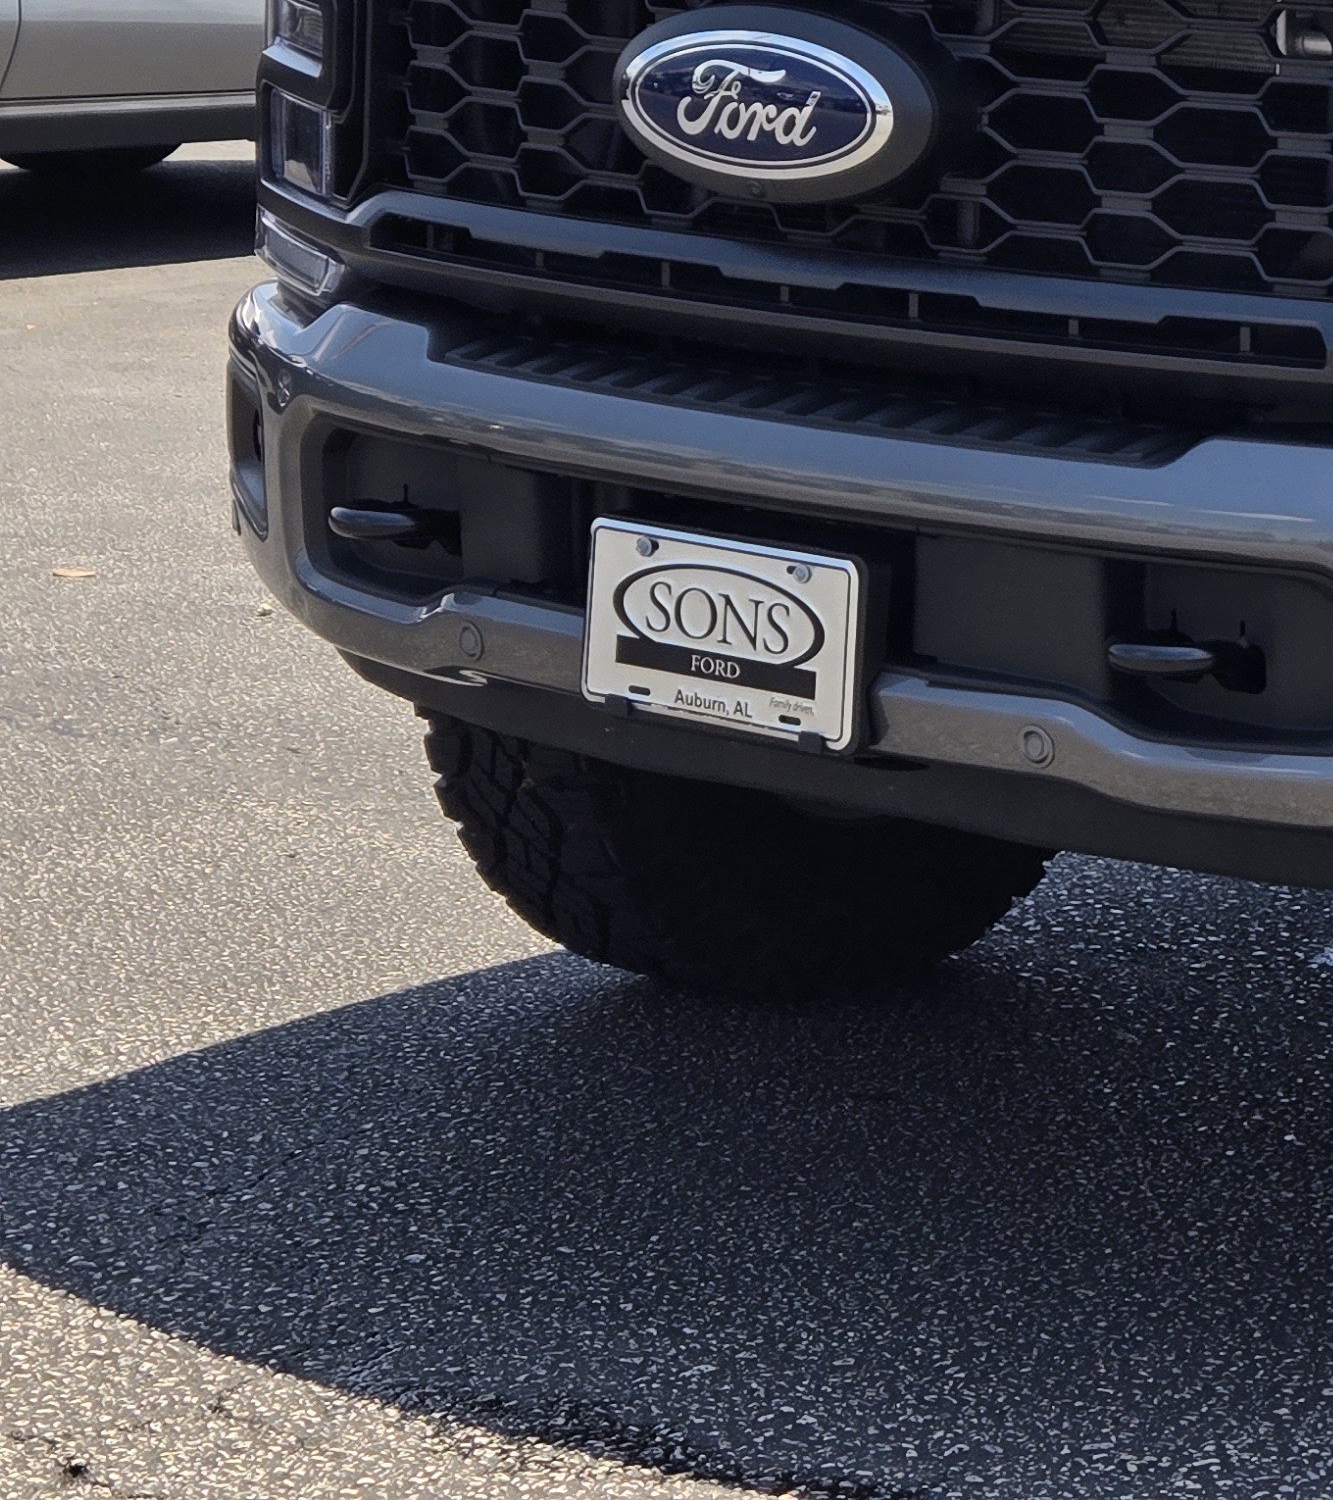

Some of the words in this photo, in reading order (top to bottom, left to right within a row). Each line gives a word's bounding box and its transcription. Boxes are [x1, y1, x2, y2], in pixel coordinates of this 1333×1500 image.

[676, 58, 822, 147] Ford
[644, 580, 791, 655] SONS
[690, 654, 741, 679] FORD
[674, 688, 730, 716] Auburn,
[733, 700, 753, 719] AL
